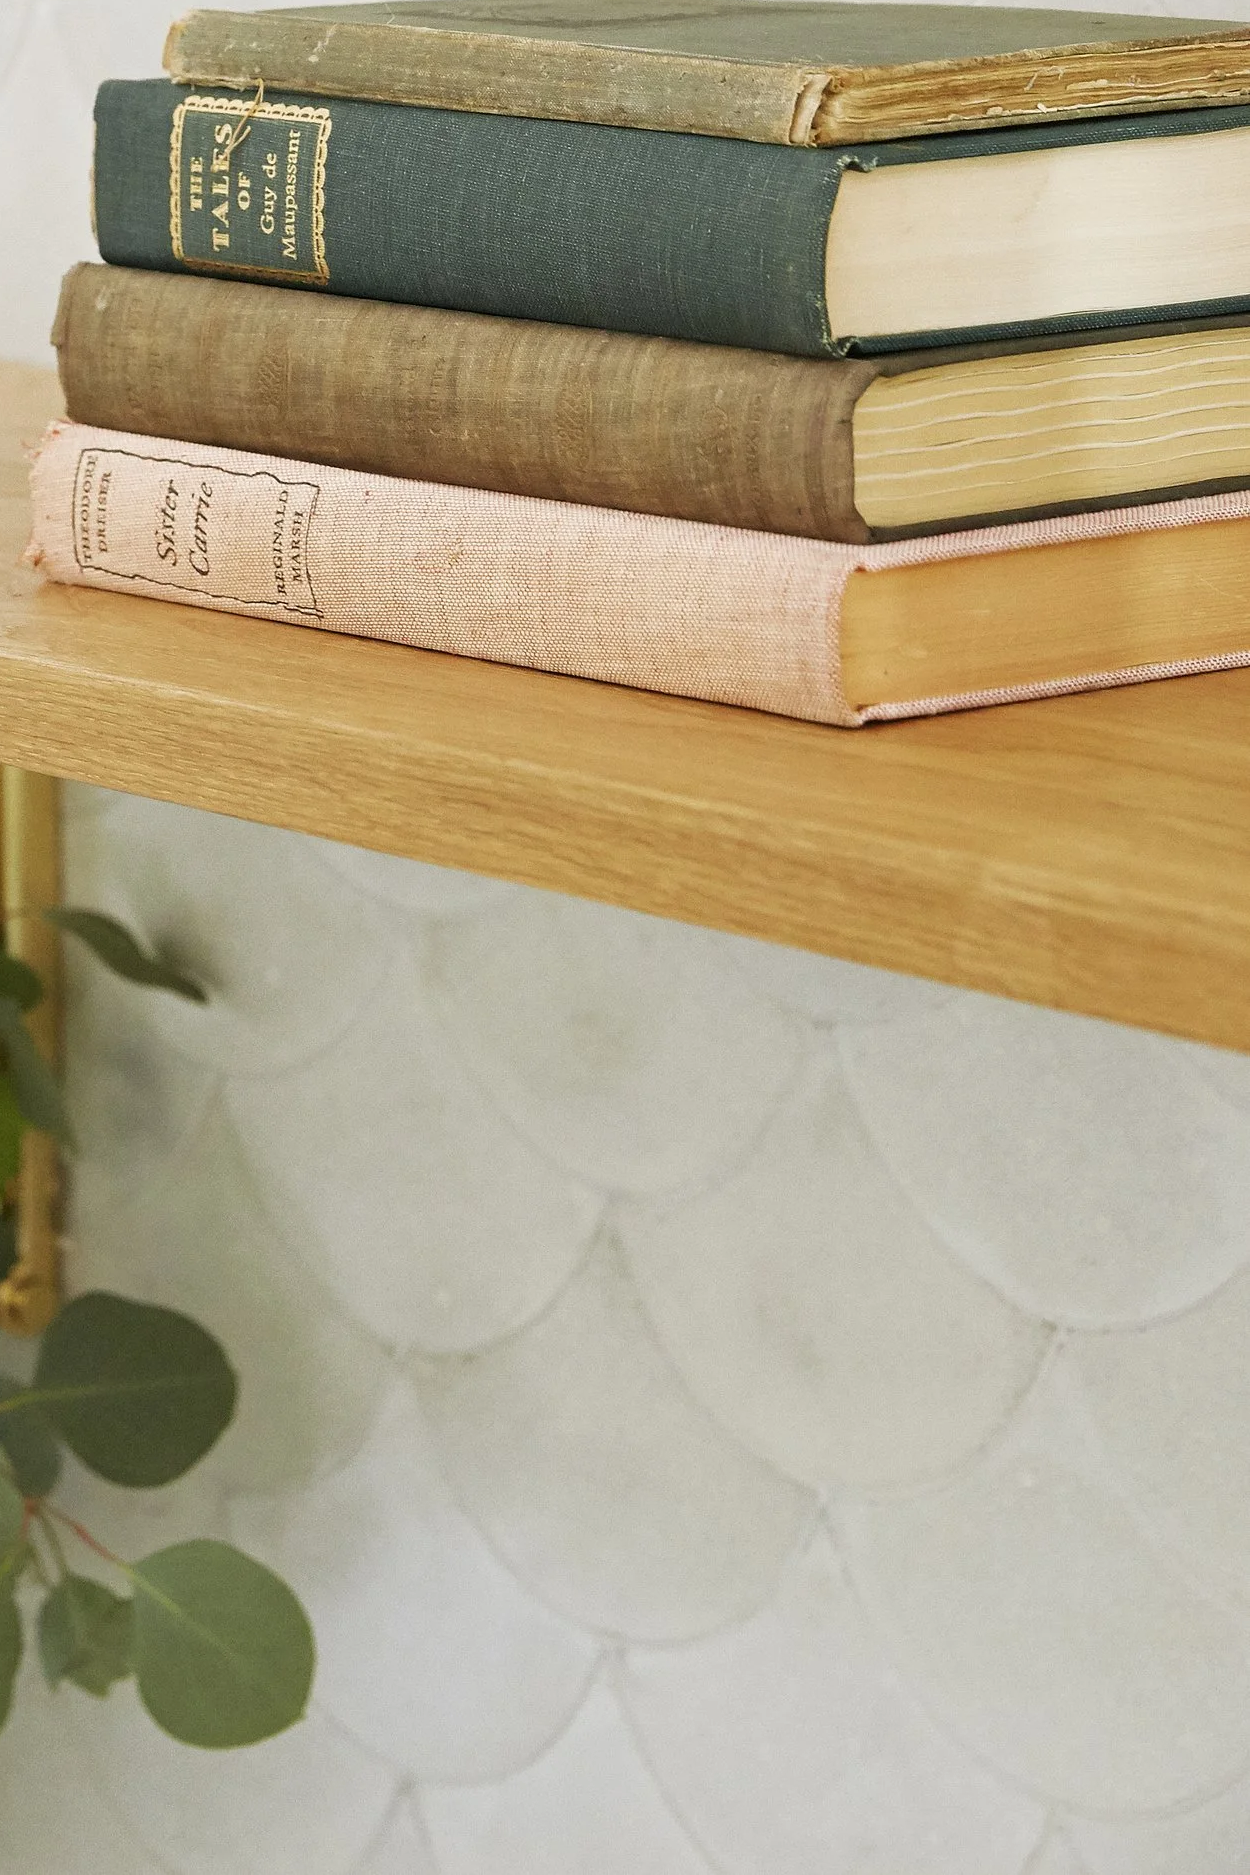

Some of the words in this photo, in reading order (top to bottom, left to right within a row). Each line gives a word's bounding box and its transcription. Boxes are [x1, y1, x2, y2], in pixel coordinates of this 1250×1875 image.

[190, 156, 203, 211] THE
[211, 123, 233, 252] TALES
[237, 171, 251, 211] OF
[262, 152, 277, 179] de
[281, 128, 301, 260] Maupassant
[260, 186, 277, 235] Guy
[77, 455, 98, 563] THEODORE
[97, 470, 112, 553] DREISER
[155, 479, 180, 567] Sister
[188, 481, 213, 577] Carrie
[271, 489, 289, 596] REGINALD
[292, 510, 305, 583] MARSH
